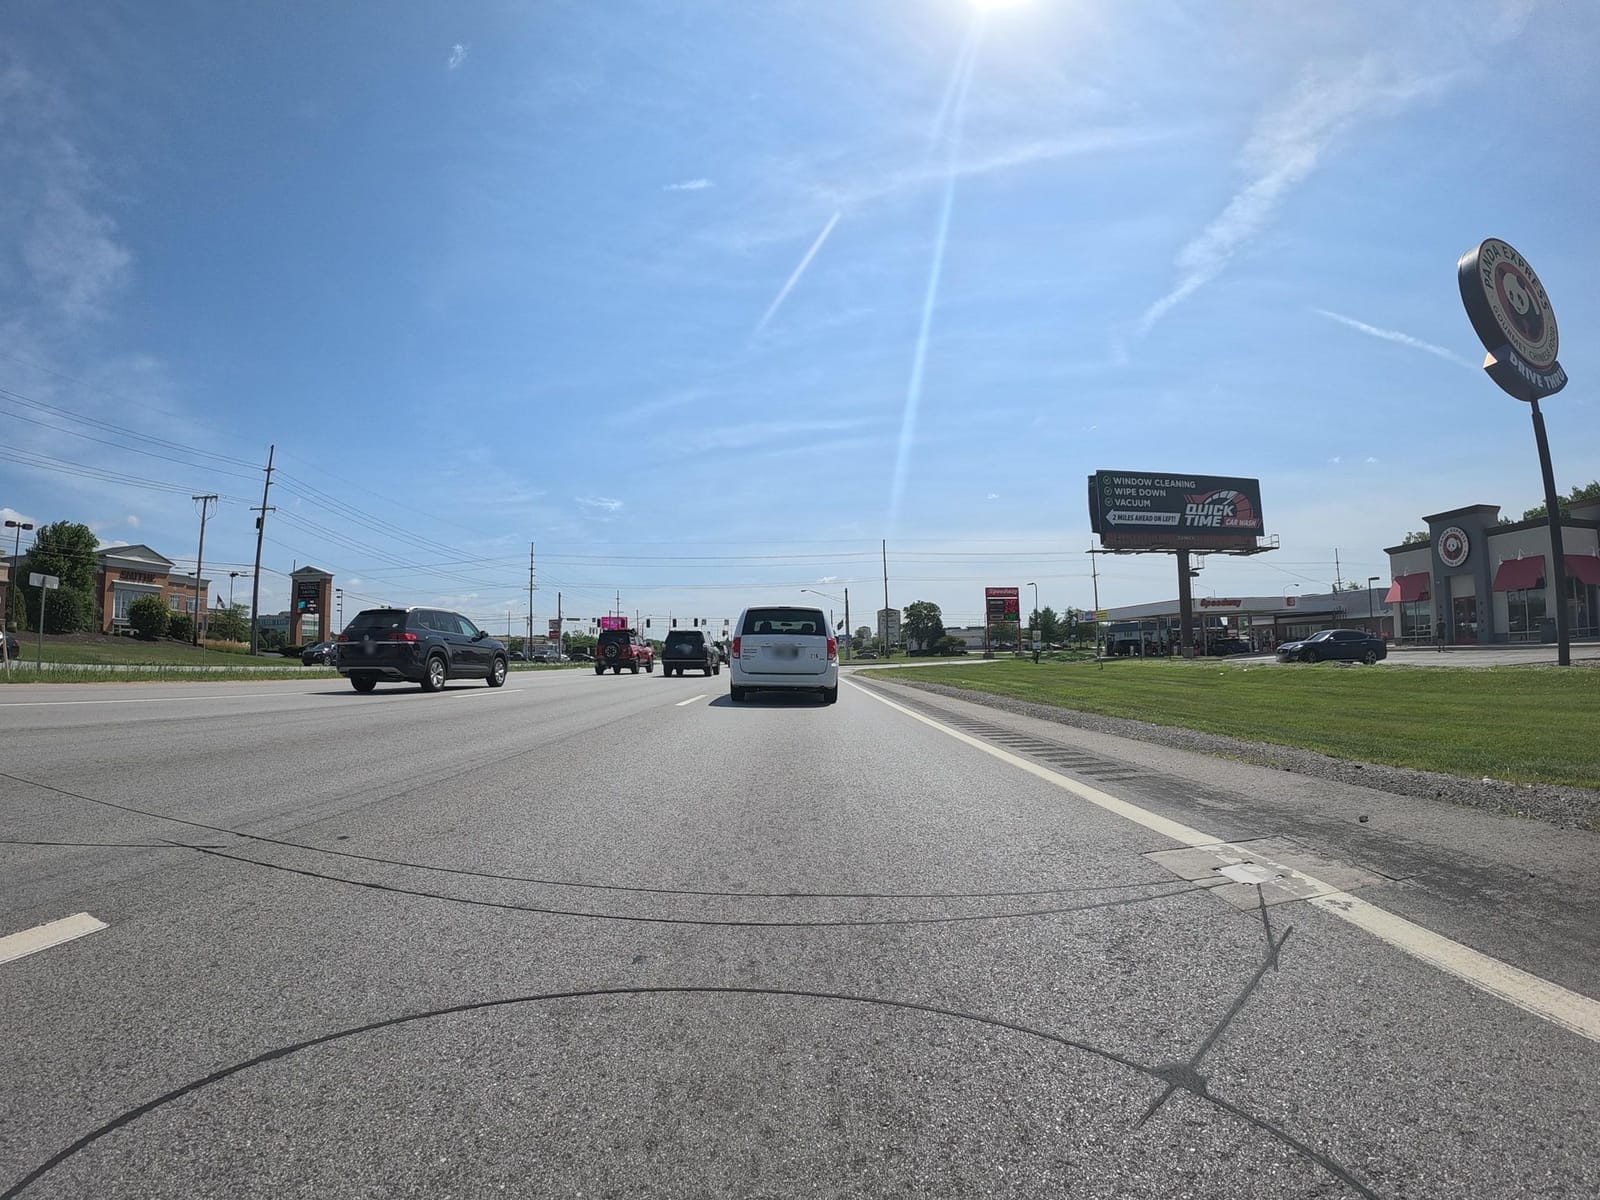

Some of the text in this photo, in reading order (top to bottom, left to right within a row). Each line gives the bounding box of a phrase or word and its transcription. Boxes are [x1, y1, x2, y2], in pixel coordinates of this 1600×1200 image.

[1482, 245, 1550, 310] PANDA EXPRESS
[1493, 305, 1526, 353] GOURMET
[1509, 351, 1565, 389] DRIVE THRU
[1112, 477, 1196, 489] WINDOW CLEANING
[1114, 487, 1166, 497] WIPE DOWN
[1114, 498, 1151, 507] VACUUM
[1185, 503, 1235, 516] QUICK
[1184, 515, 1222, 527] TIME
[1225, 518, 1257, 527] CAR WASH
[1199, 599, 1242, 609] Speedway
